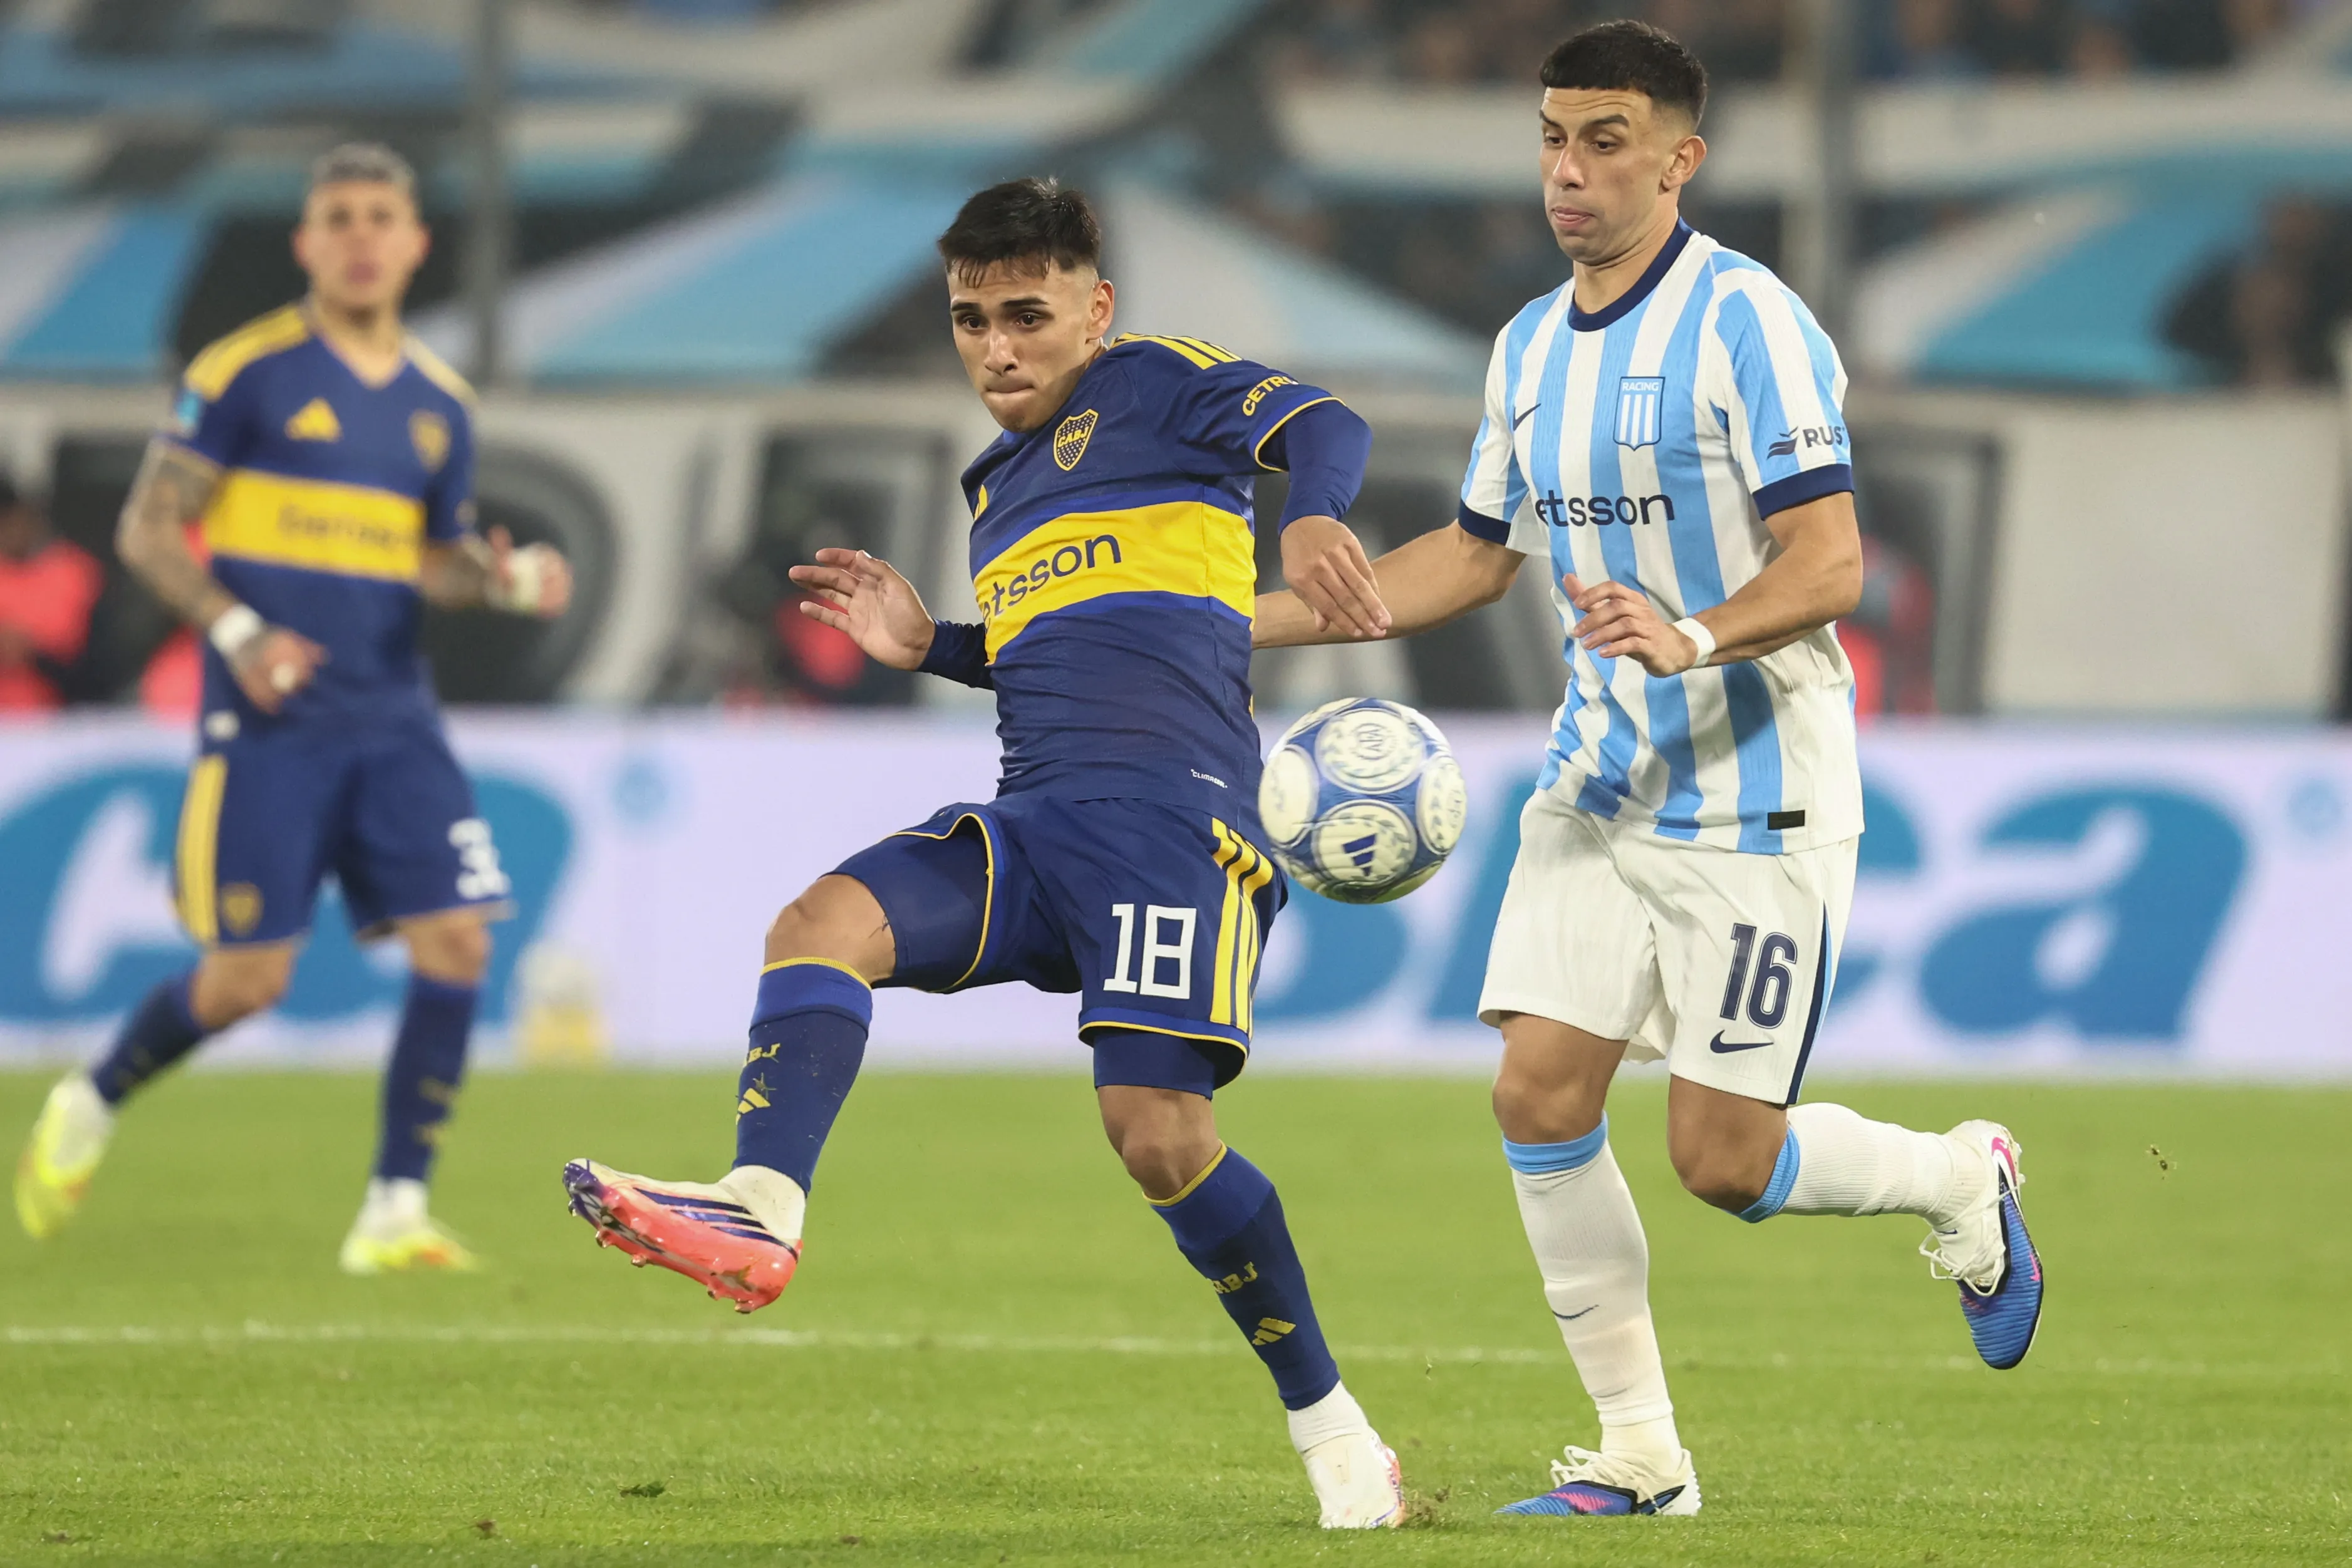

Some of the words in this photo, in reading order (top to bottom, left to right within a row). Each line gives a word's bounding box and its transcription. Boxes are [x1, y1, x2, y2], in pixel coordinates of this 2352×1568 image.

[1622, 382, 1659, 391] RACING
[1057, 426, 1089, 447] CABJ
[1803, 426, 1845, 448] RUS
[1103, 903, 1196, 999] 18
[1719, 922, 1798, 1029] 16
[742, 1042, 780, 1067] BJ
